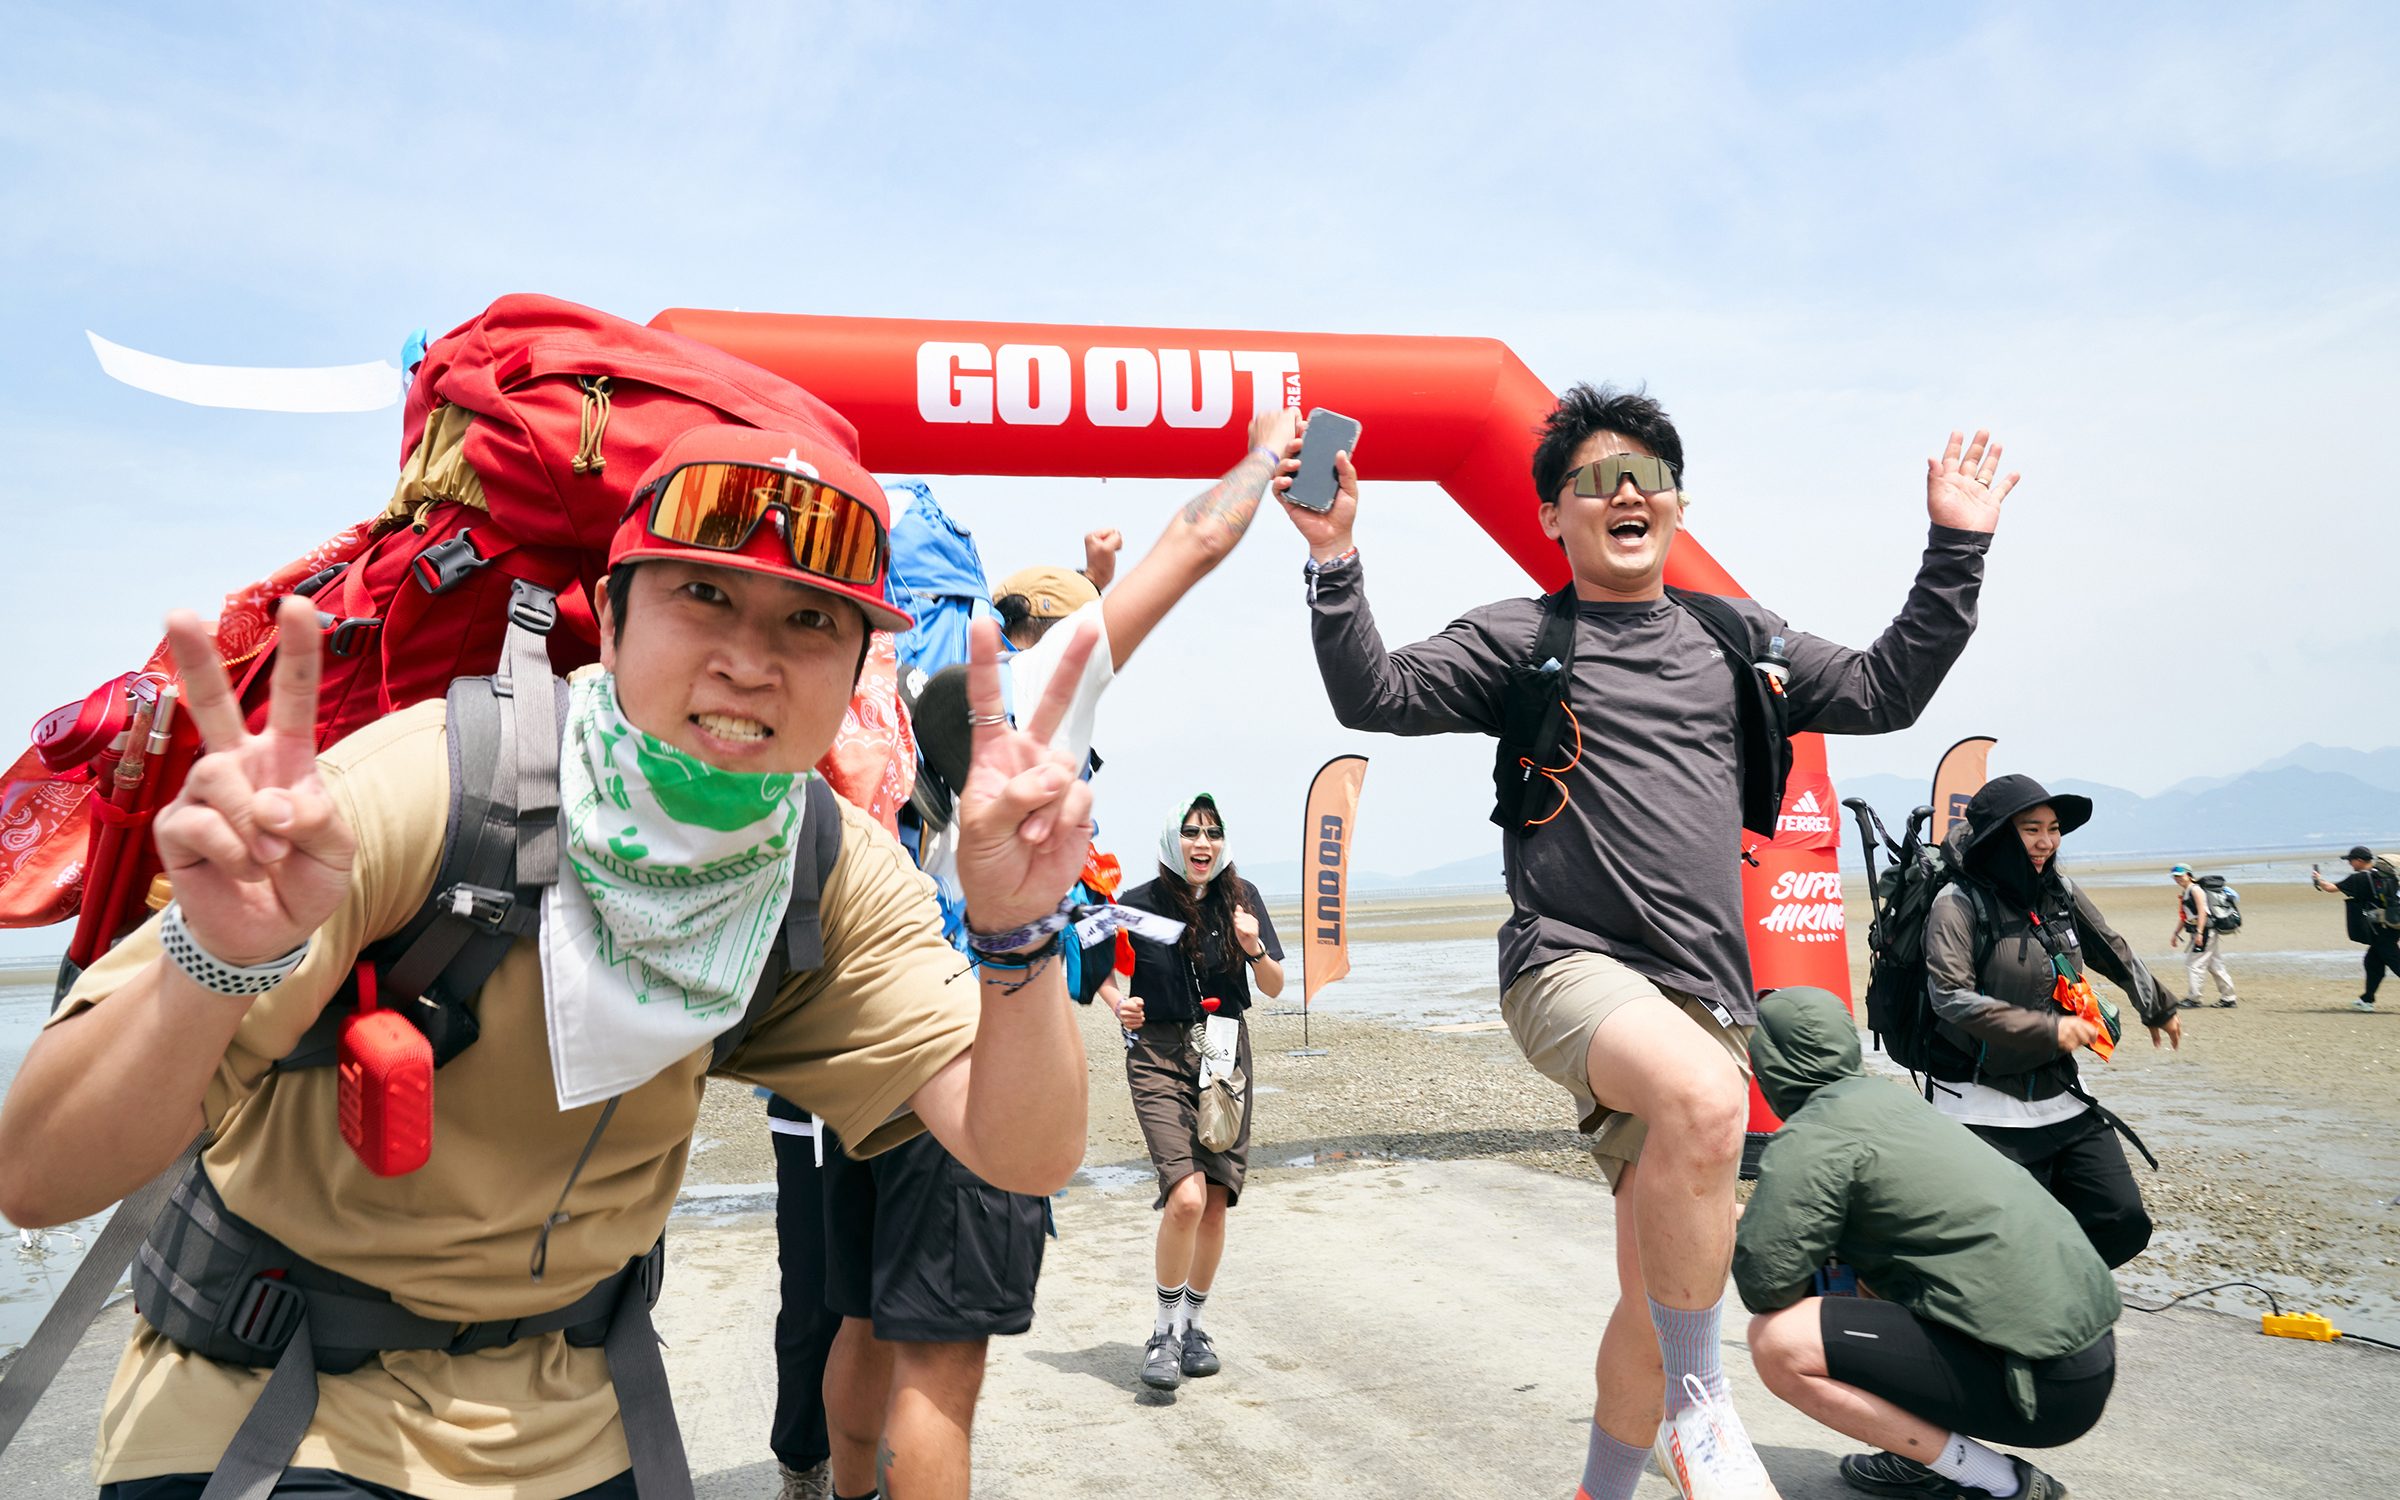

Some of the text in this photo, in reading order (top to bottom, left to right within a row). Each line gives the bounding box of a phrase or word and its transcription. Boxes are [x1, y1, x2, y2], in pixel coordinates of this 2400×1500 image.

[916, 341, 1299, 429] GO OUT
[1286, 373, 1301, 407] REA
[1317, 815, 1342, 946] GO OUT
[1770, 870, 1843, 900] SUPER
[1759, 902, 1845, 933] HIKING
